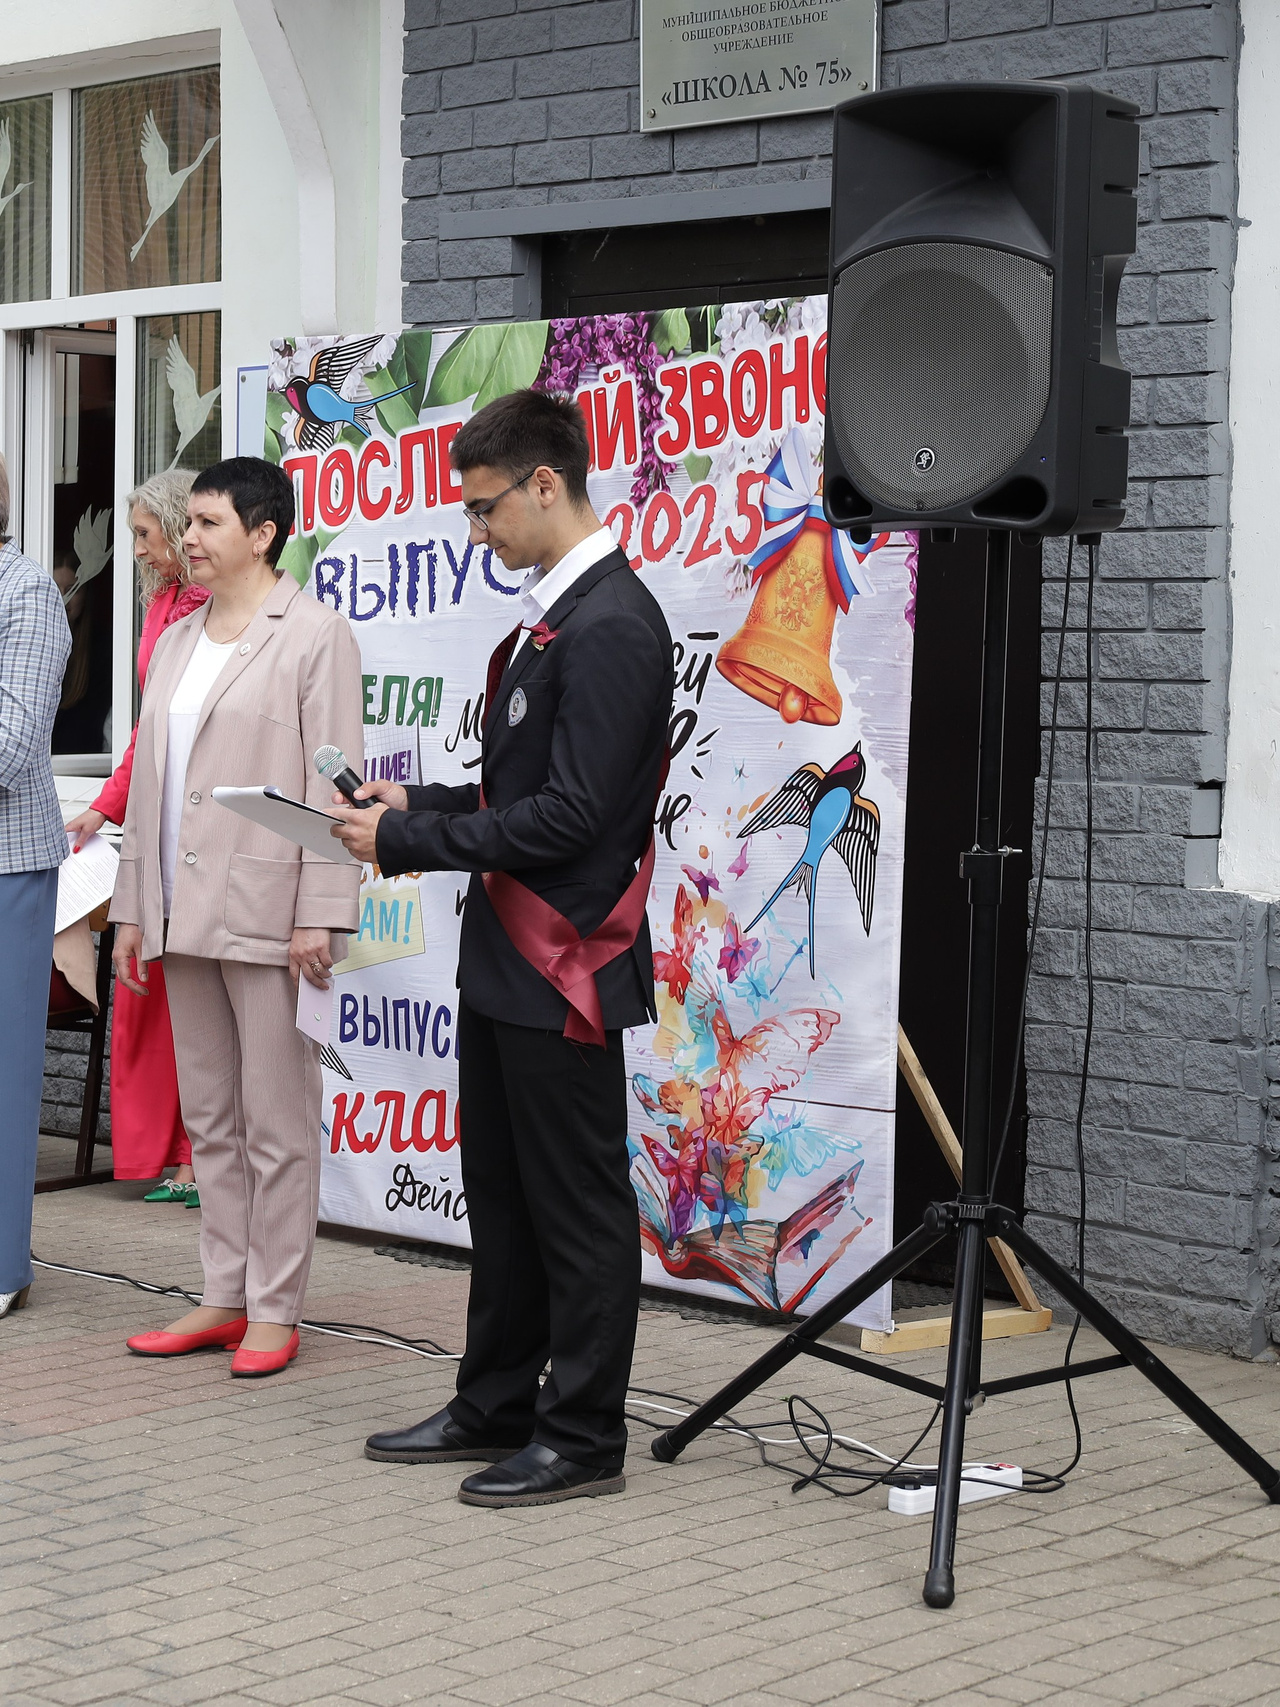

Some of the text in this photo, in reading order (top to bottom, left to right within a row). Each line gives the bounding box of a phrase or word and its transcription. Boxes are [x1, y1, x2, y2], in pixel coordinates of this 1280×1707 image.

[662, 3, 767, 29] МУНИЦИПАЛЬНОЕ
[682, 11, 829, 42] ОБЩЕОБРАЗОВАТЕЛЬНОЕ
[713, 33, 794, 54] УЧРЕЖДЕНИЕ
[661, 58, 852, 106] «ШКОЛА № 75»
[603, 469, 770, 571] 2025
[362, 674, 444, 728] ЕЛЯ!
[356, 896, 414, 945] АМ!
[339, 993, 460, 1060] ВЫПУС
[330, 1089, 461, 1154] кла
[385, 1163, 469, 1222] Дейс
